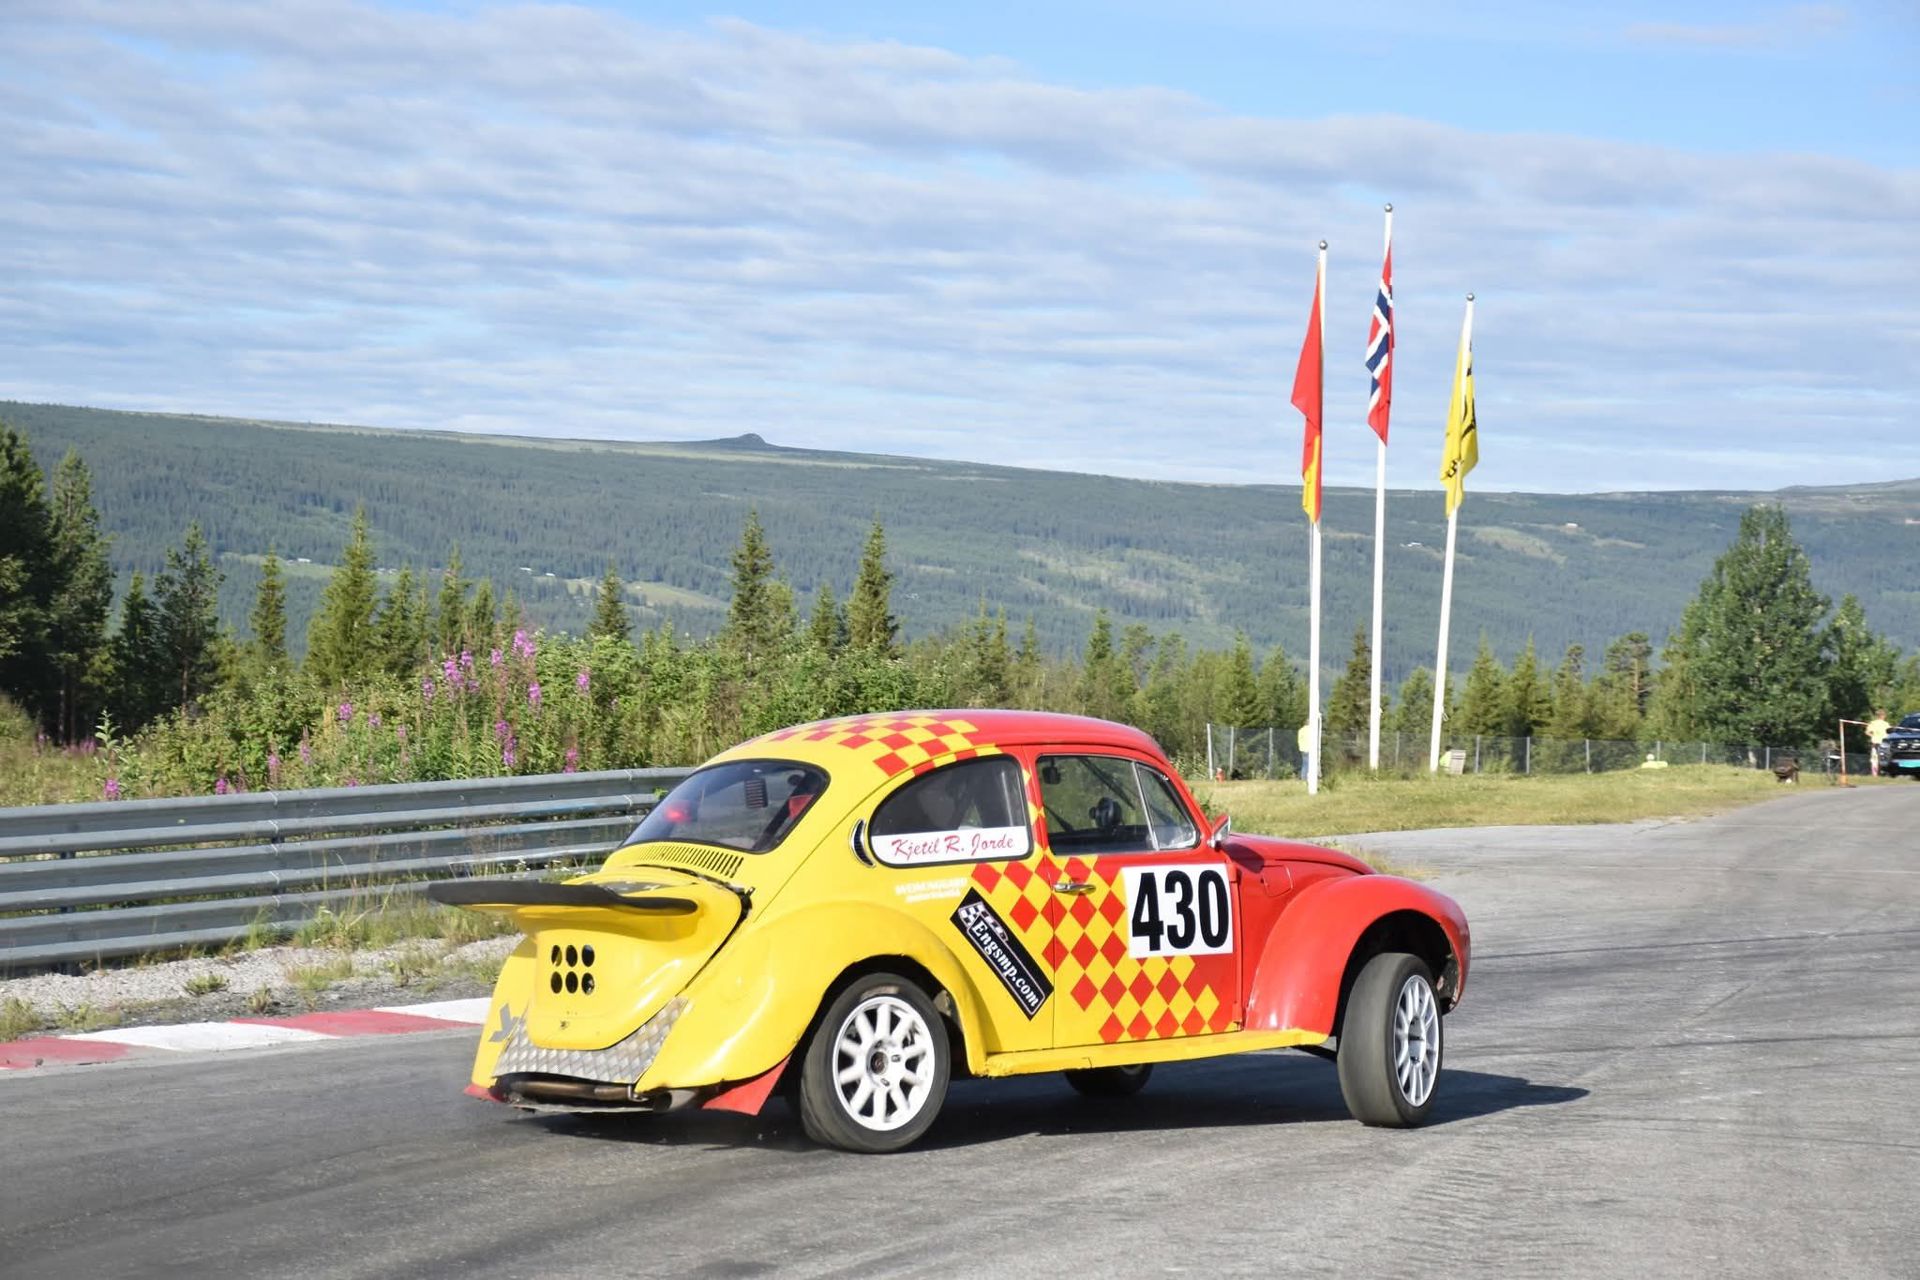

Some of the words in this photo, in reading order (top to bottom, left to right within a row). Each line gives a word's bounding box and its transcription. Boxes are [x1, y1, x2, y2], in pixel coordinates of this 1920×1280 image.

[891, 838, 941, 860] Kjetil
[944, 835, 965, 853] R.
[971, 833, 1014, 856] Jorde
[1131, 869, 1229, 952] 430
[972, 921, 1039, 1007] Engsmp.com
